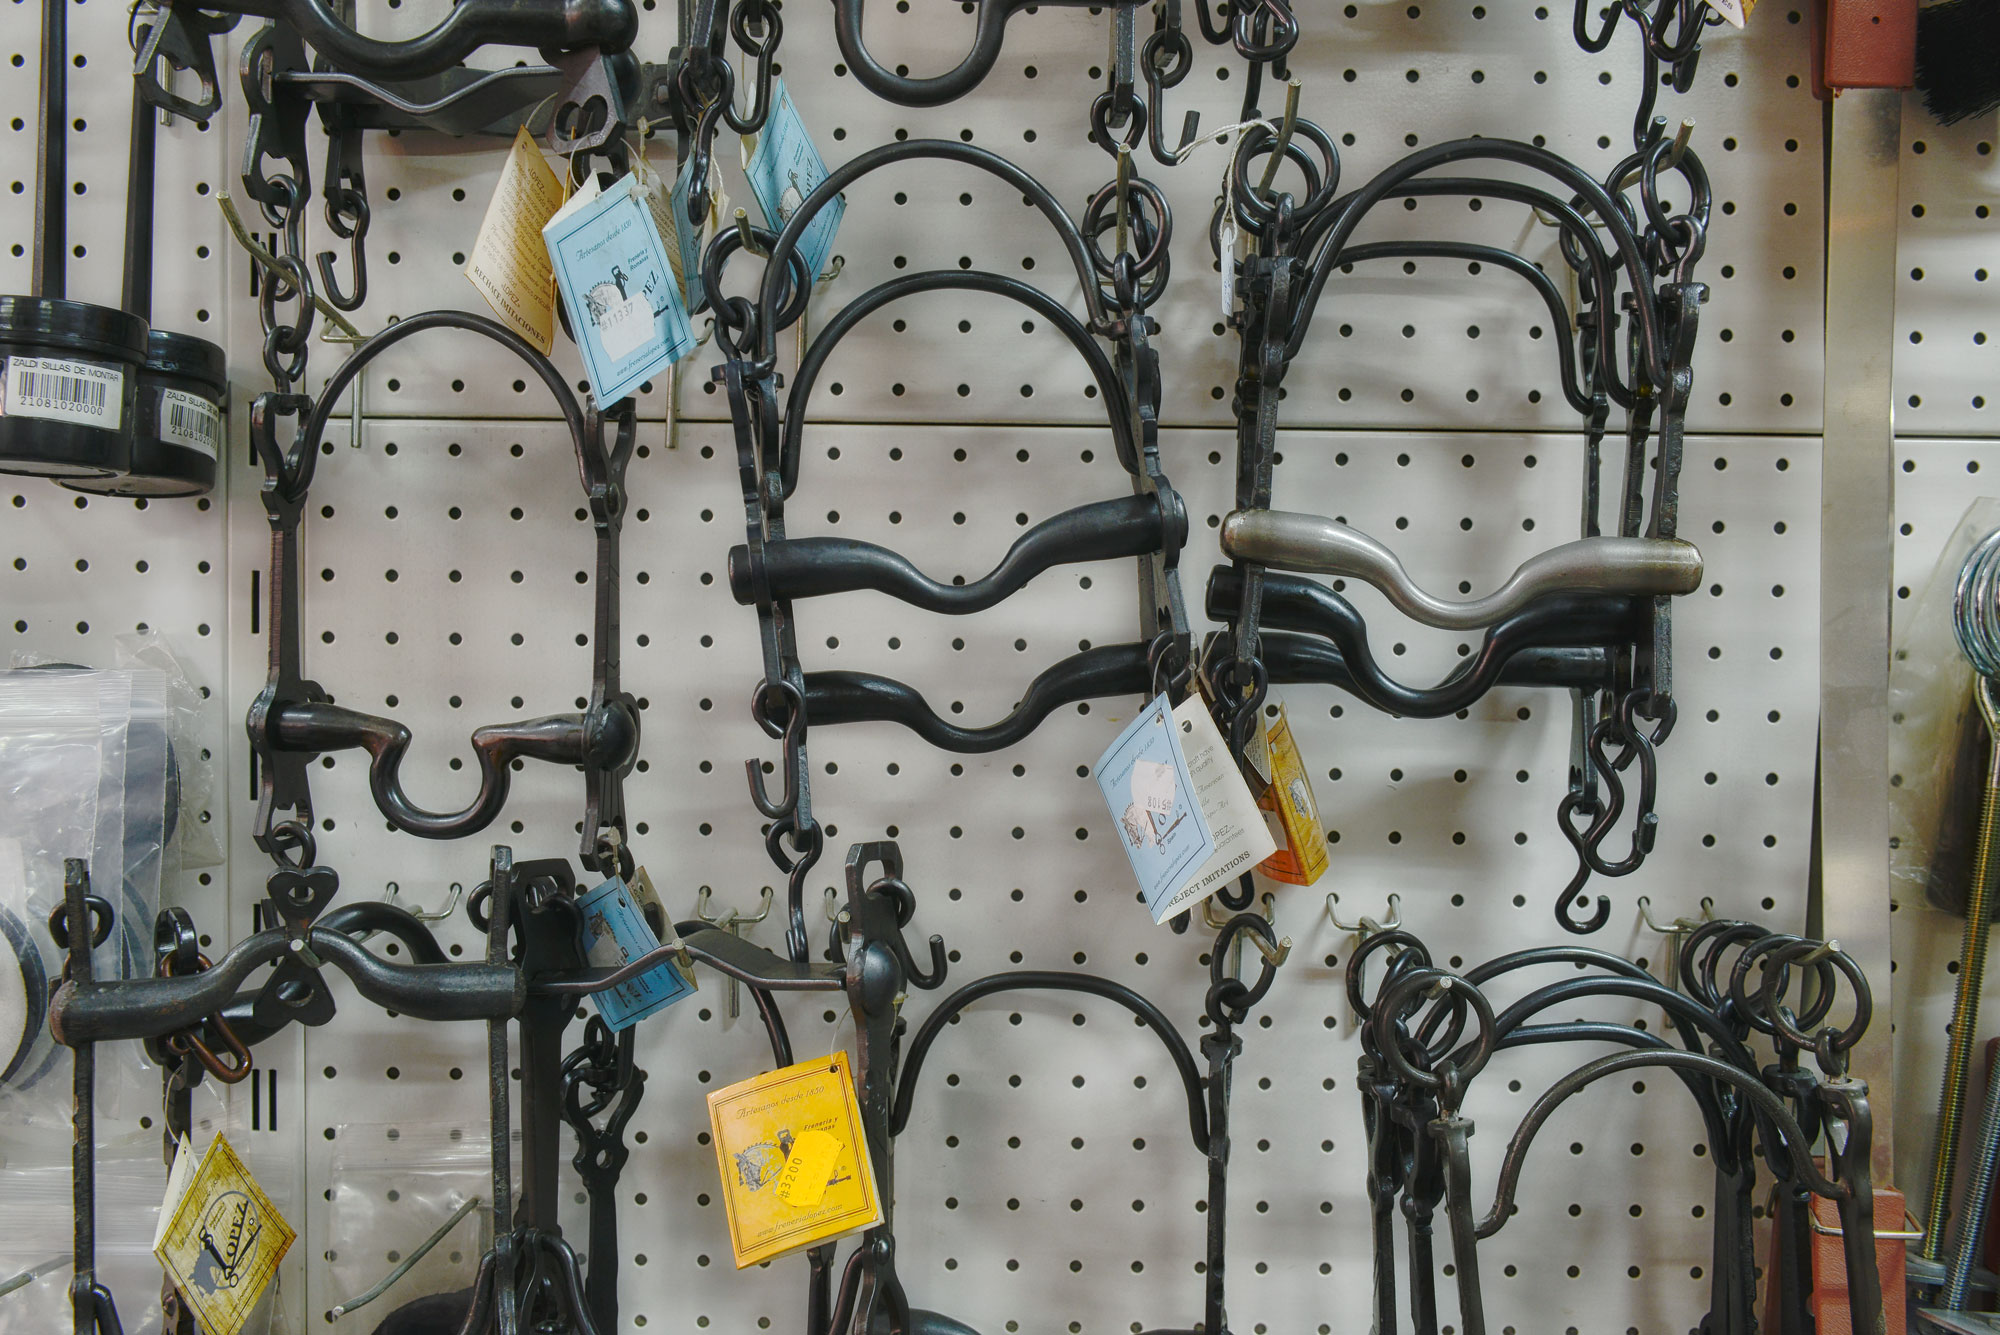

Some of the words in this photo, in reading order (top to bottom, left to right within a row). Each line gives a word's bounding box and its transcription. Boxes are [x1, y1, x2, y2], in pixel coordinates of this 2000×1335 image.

[474, 265, 501, 301] RECHACE
[500, 298, 545, 344] IMITACIONES
[13, 358, 38, 369] ZALDI
[41, 361, 72, 374] SILLAS
[74, 364, 86, 376] DE
[88, 368, 120, 383] MONTAR
[20, 396, 104, 416] 21081020000
[166, 390, 187, 402] ZALDI
[188, 396, 207, 410] SILLAS
[1168, 882, 1201, 908] REJECT
[1201, 850, 1251, 887] IMITATIONS
[736, 1100, 779, 1119] Artesanos
[780, 1091, 804, 1105] desde
[803, 1118, 833, 1131] Freneria
[779, 1157, 803, 1199] #3200
[757, 1203, 844, 1238] www.frenerialopez.com
